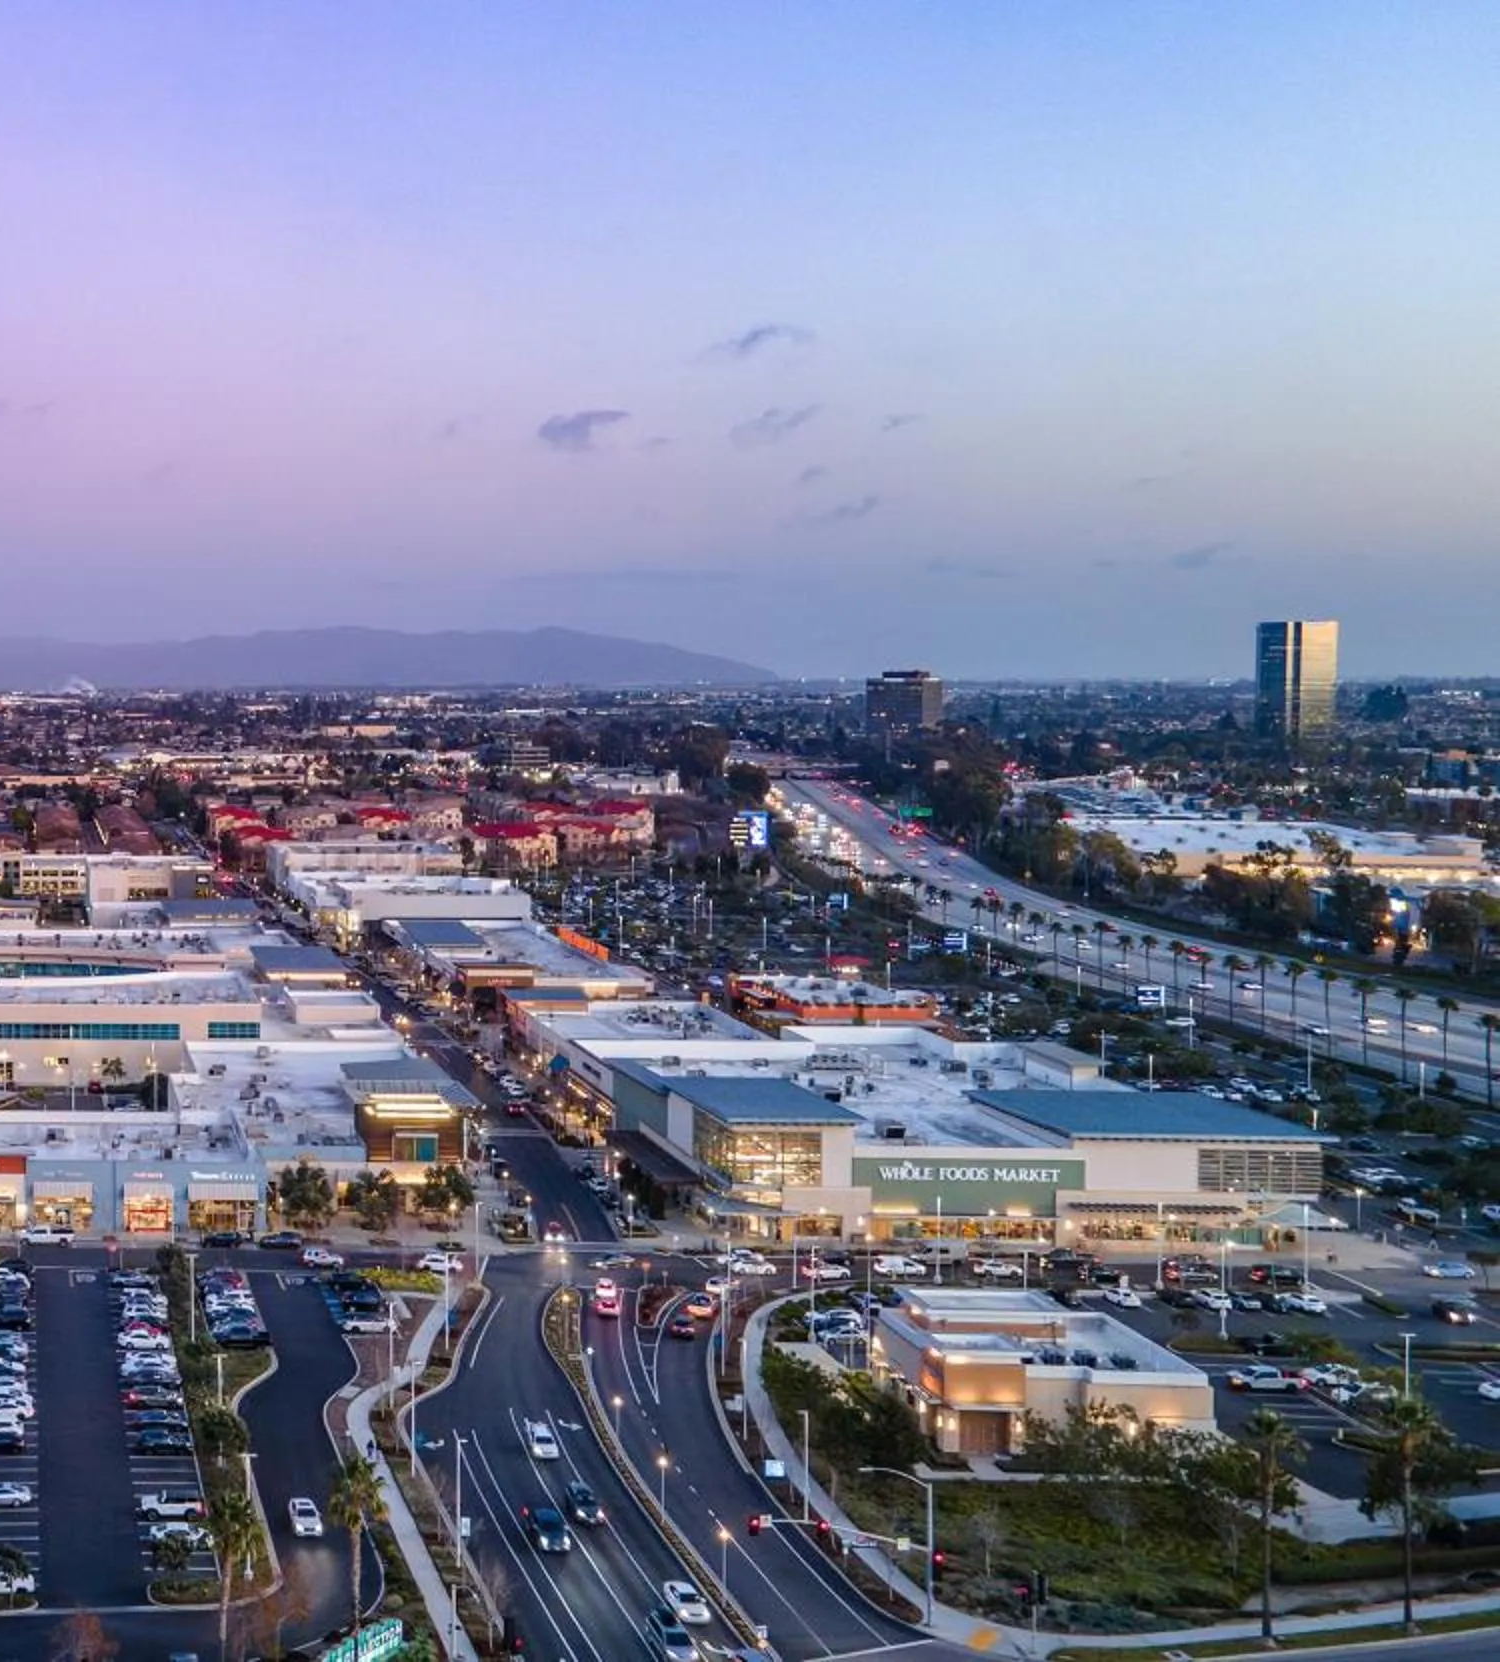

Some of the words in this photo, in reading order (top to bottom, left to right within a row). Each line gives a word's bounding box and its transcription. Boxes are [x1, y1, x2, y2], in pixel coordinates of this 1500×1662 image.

[879, 1165, 932, 1181] WHOLE
[939, 1167, 989, 1182] FOODS
[993, 1168, 1061, 1183] MARKET
